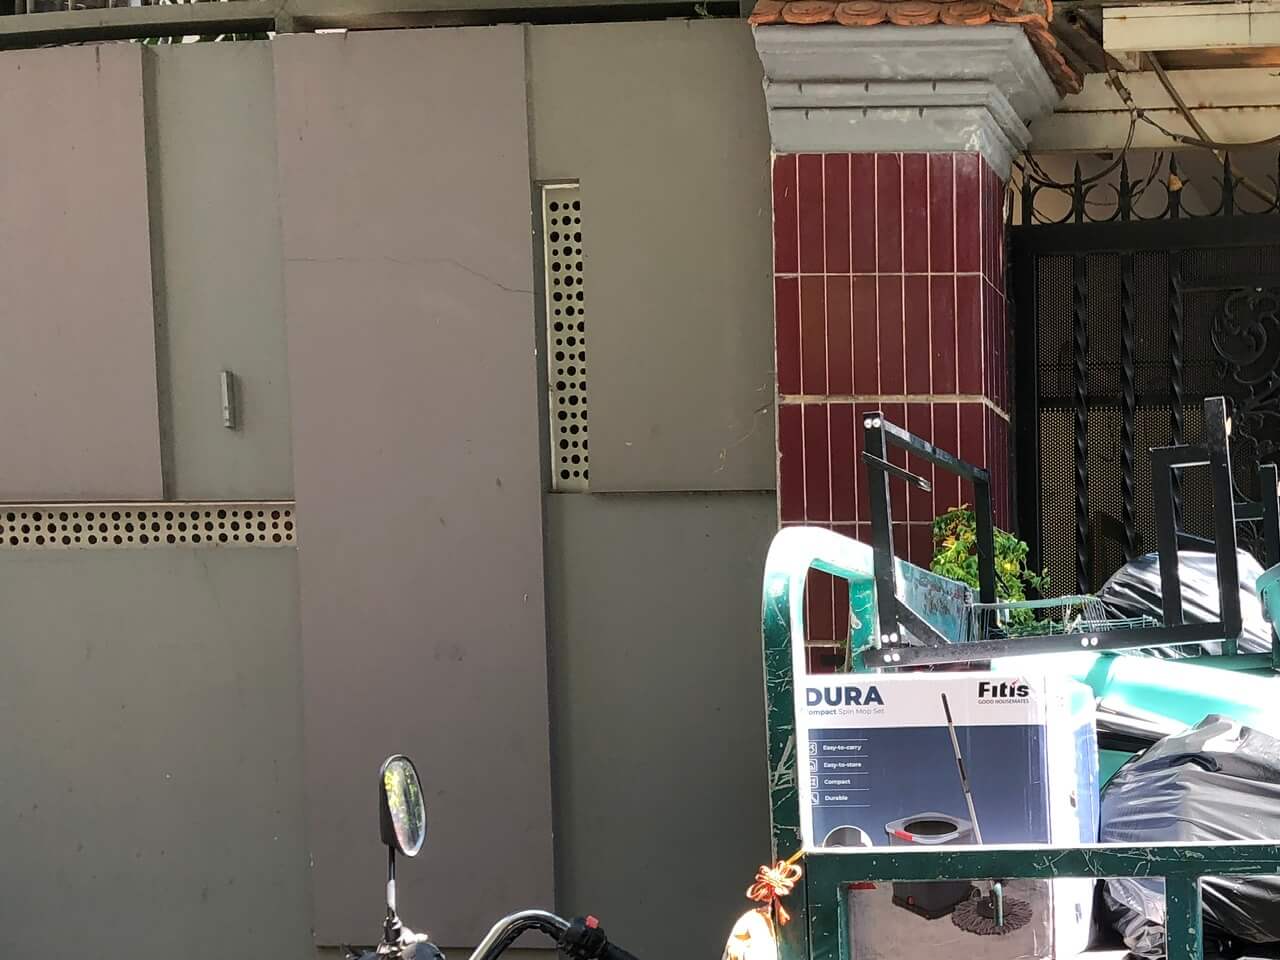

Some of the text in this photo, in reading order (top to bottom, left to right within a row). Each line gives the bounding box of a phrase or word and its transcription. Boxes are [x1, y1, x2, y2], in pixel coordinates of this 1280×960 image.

[805, 685, 885, 706] DURA
[978, 679, 1030, 698] Fitis
[808, 708, 837, 717] ompact
